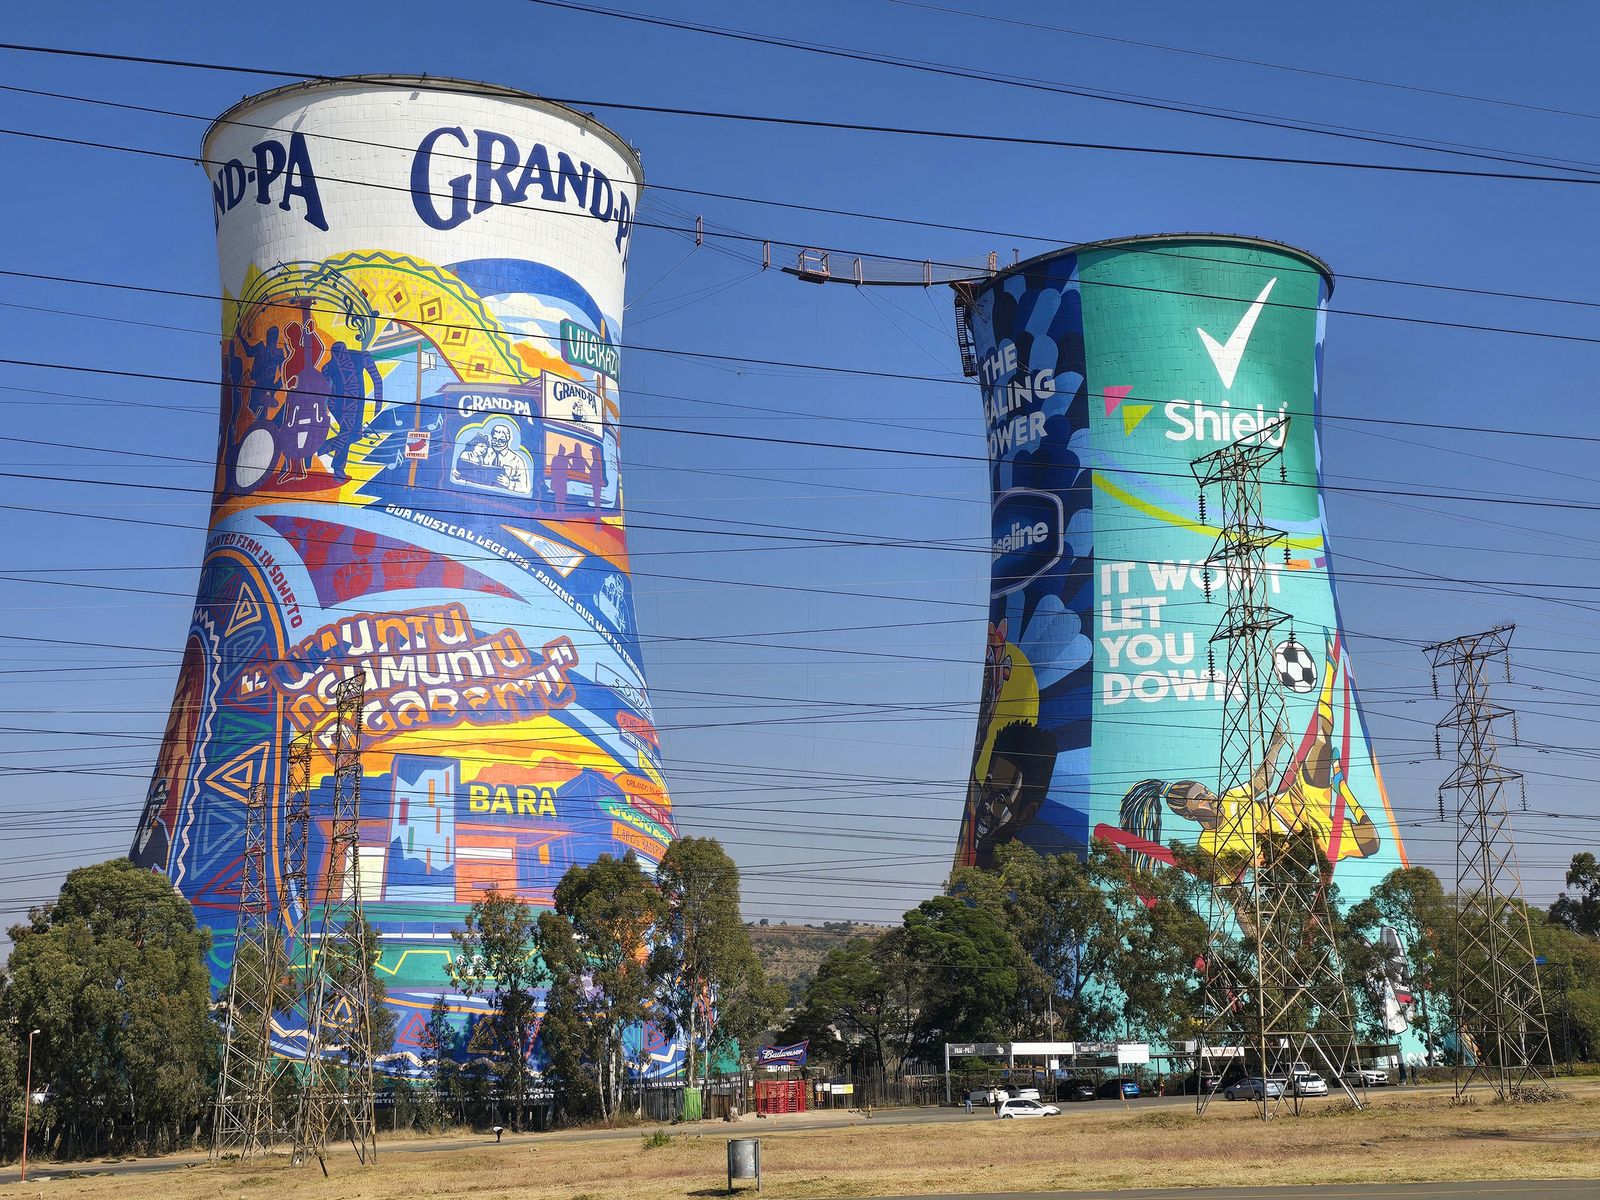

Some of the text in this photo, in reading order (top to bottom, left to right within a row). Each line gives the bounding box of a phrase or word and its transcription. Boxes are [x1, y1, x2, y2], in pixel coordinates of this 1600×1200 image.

[212, 127, 633, 274] ND-PA GRAND-P
[983, 343, 1018, 386] THE
[458, 395, 534, 425] GRAND-PA
[553, 381, 598, 416] GRAND-PA
[988, 411, 1048, 461] OWER
[1164, 399, 1286, 447] Shield
[235, 535, 263, 556] FIRM
[259, 550, 275, 569] IN
[268, 565, 303, 628] SOWETO
[385, 503, 412, 520] OUR
[413, 512, 475, 542] MUSICAL
[476, 535, 531, 572] LEGENDS
[535, 570, 575, 606] PAVING
[575, 602, 594, 625] OUR
[611, 635, 622, 653] TO
[1101, 562, 1136, 594] IT
[1102, 596, 1167, 632] LET
[1100, 632, 1195, 668] YOU
[469, 784, 558, 817] BARA
[762, 1049, 804, 1060] Budweiser
